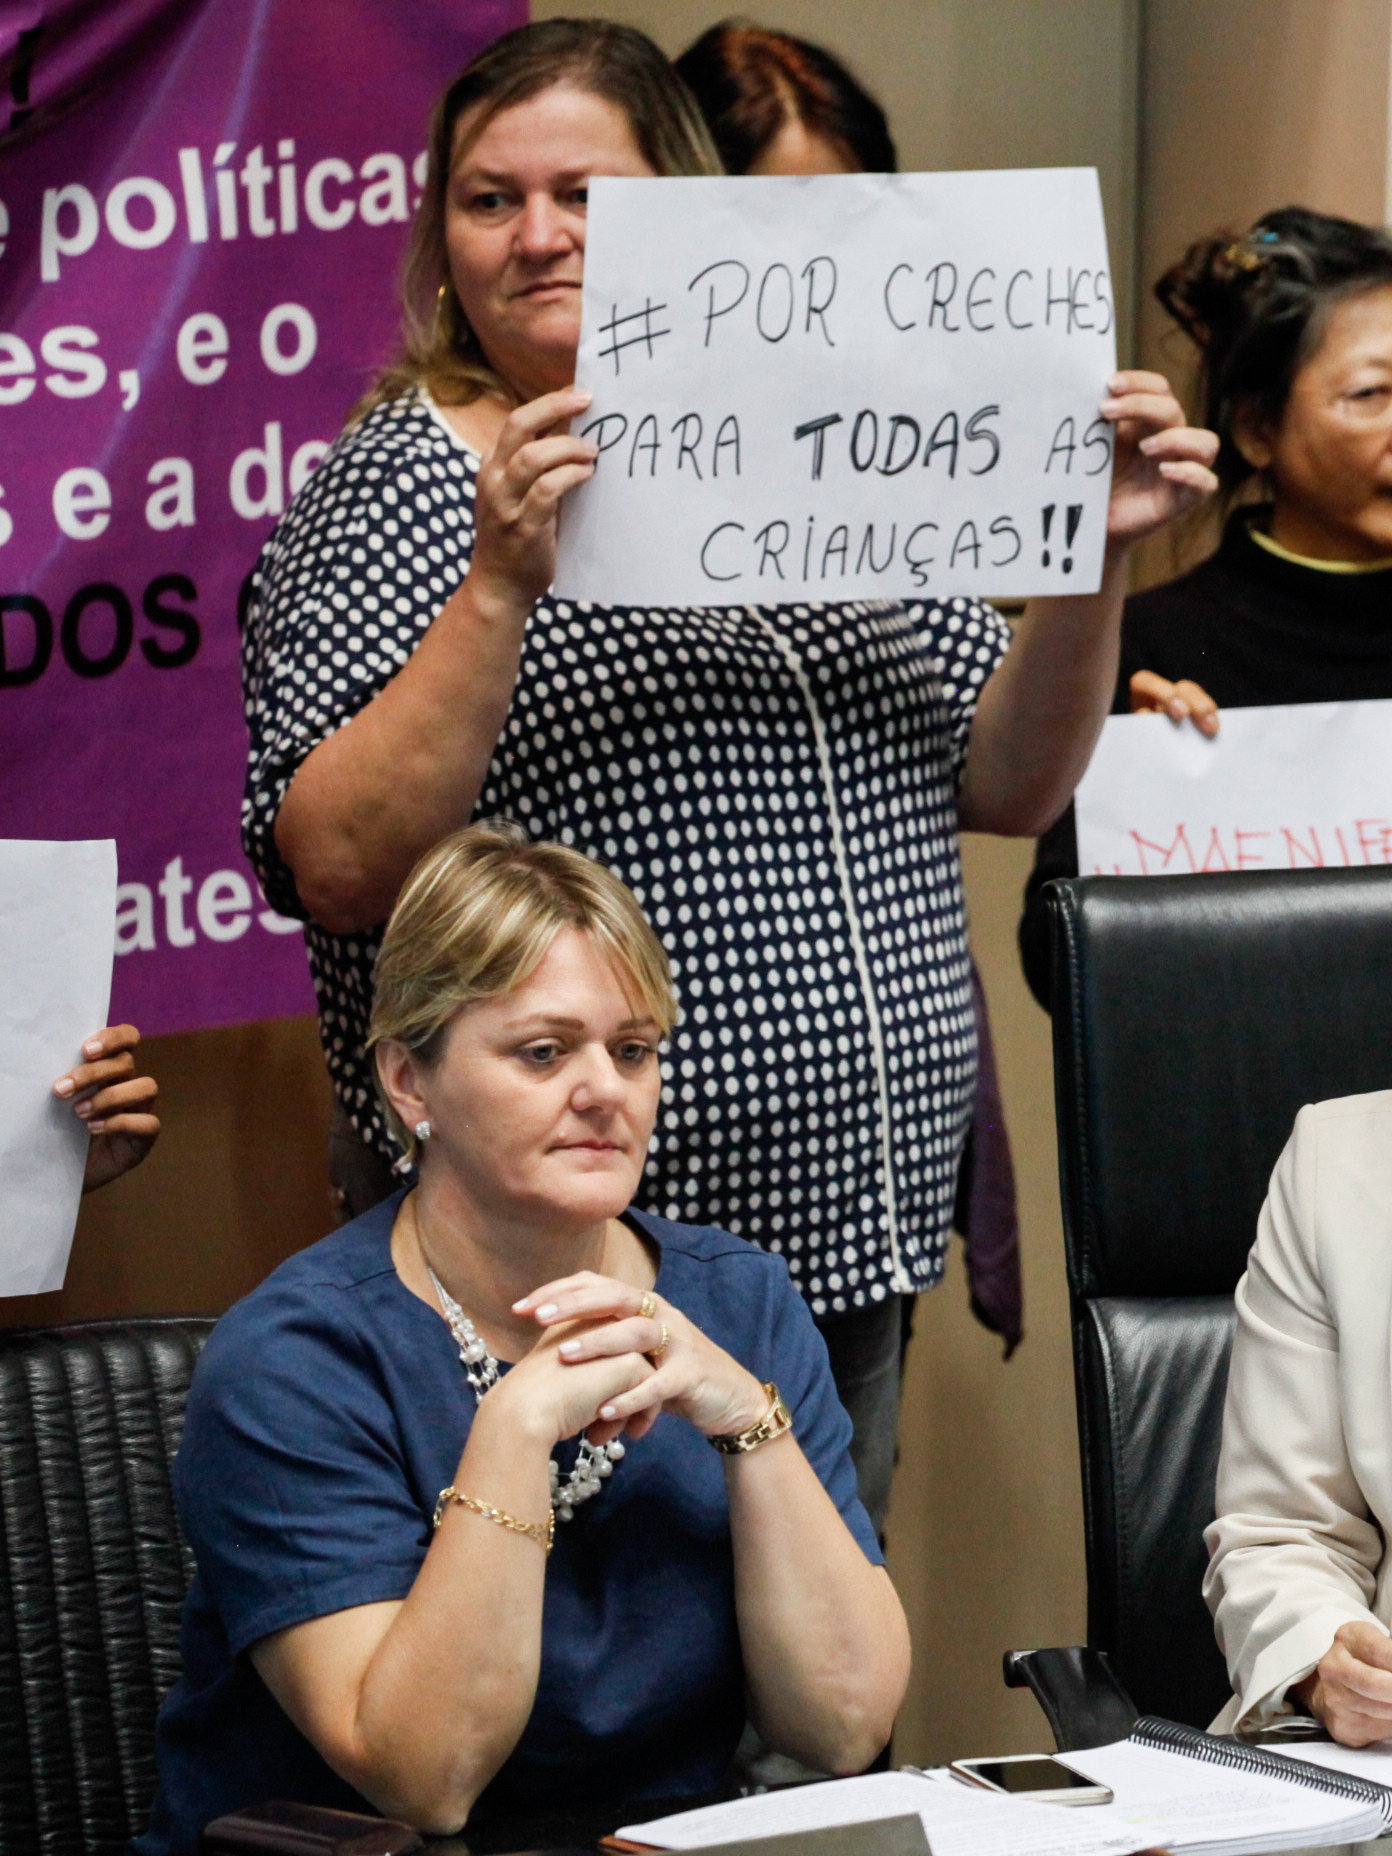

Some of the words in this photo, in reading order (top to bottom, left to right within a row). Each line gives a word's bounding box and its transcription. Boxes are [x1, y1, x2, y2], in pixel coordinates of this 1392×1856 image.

[884, 261, 1112, 335] CRECHES
[177, 312, 230, 387] e
[260, 303, 318, 376] o
[580, 411, 742, 481] PARA
[793, 404, 1001, 482] TODAS
[1044, 416, 1113, 476] AS
[52, 467, 112, 540] e
[145, 456, 196, 532] a
